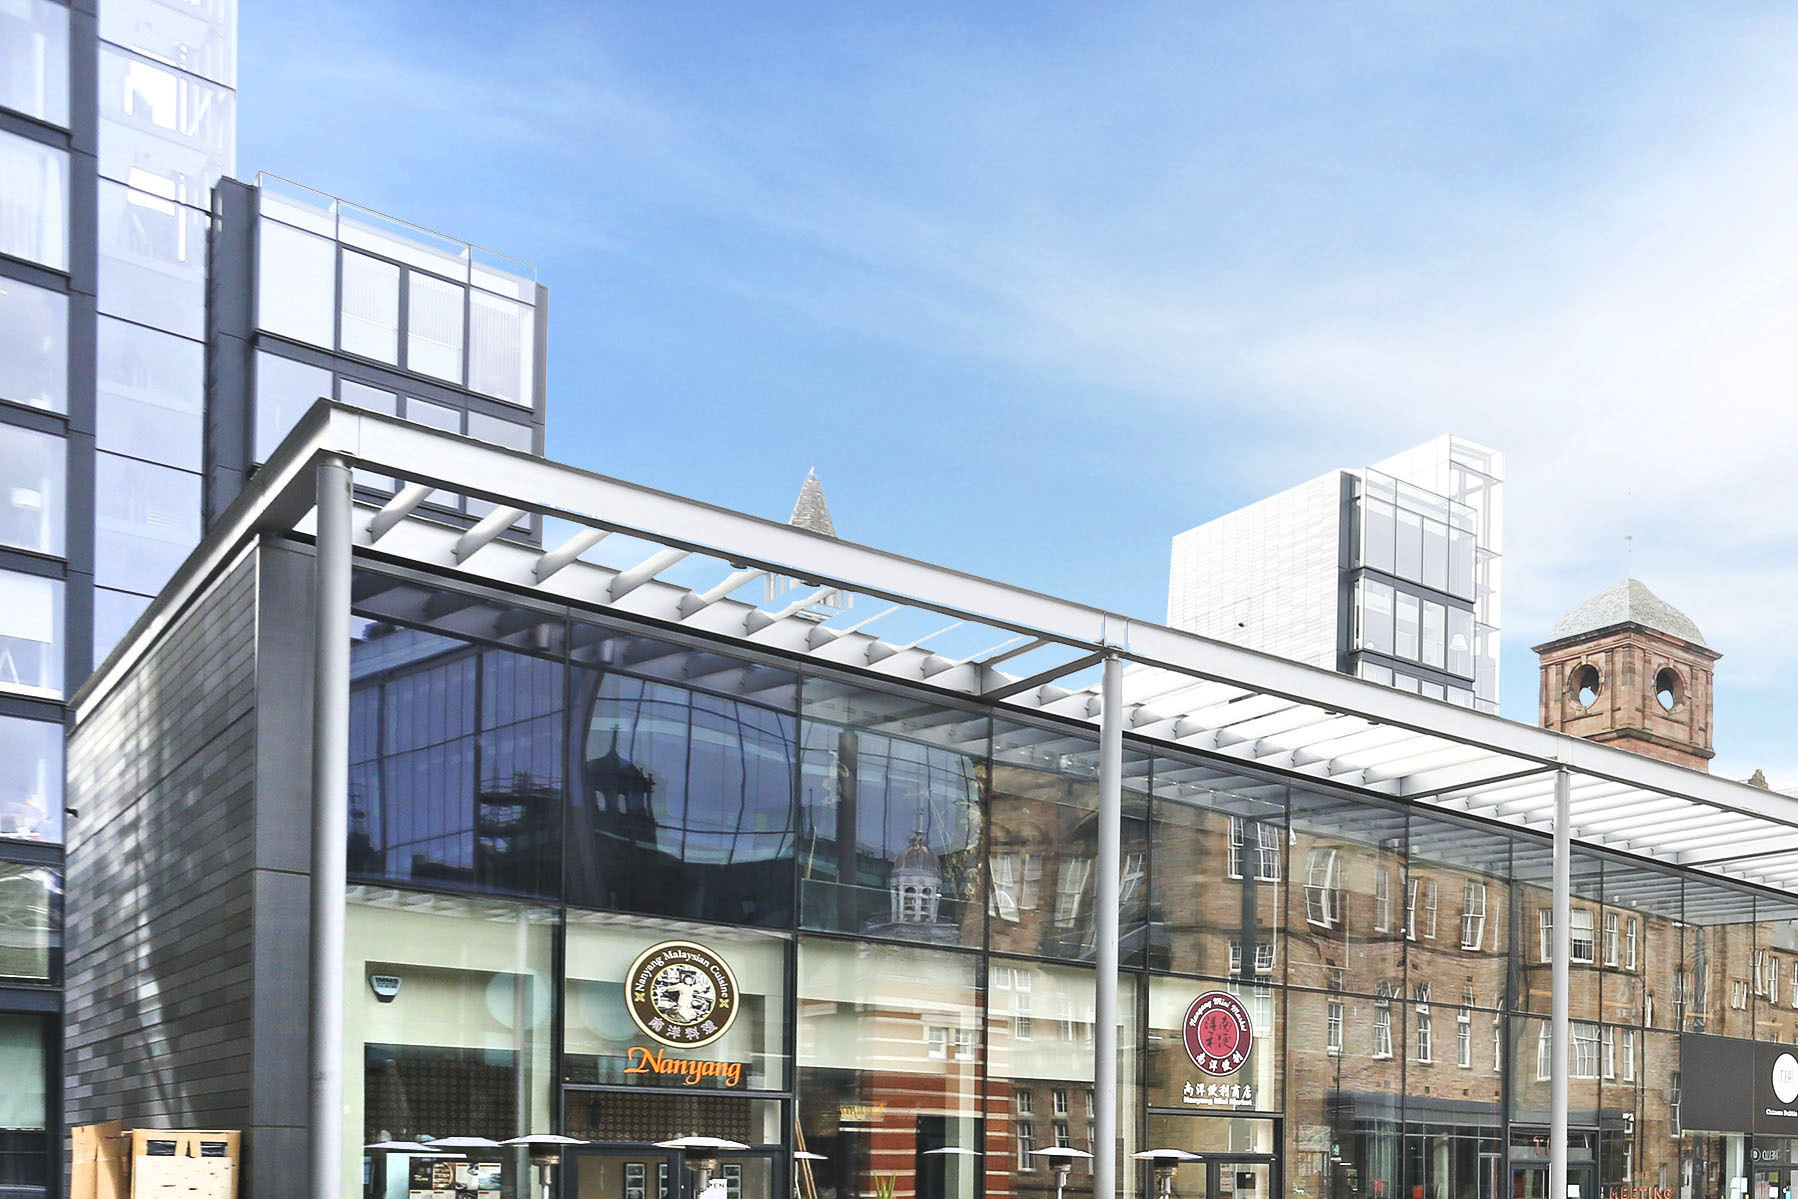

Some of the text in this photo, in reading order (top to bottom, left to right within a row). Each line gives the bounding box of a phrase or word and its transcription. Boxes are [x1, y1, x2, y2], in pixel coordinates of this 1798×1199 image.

[635, 950, 729, 998] Nanyang Malaysian Cuisine
[624, 1046, 742, 1087] Nanyang
[1609, 1186, 1673, 1199] MEETING
